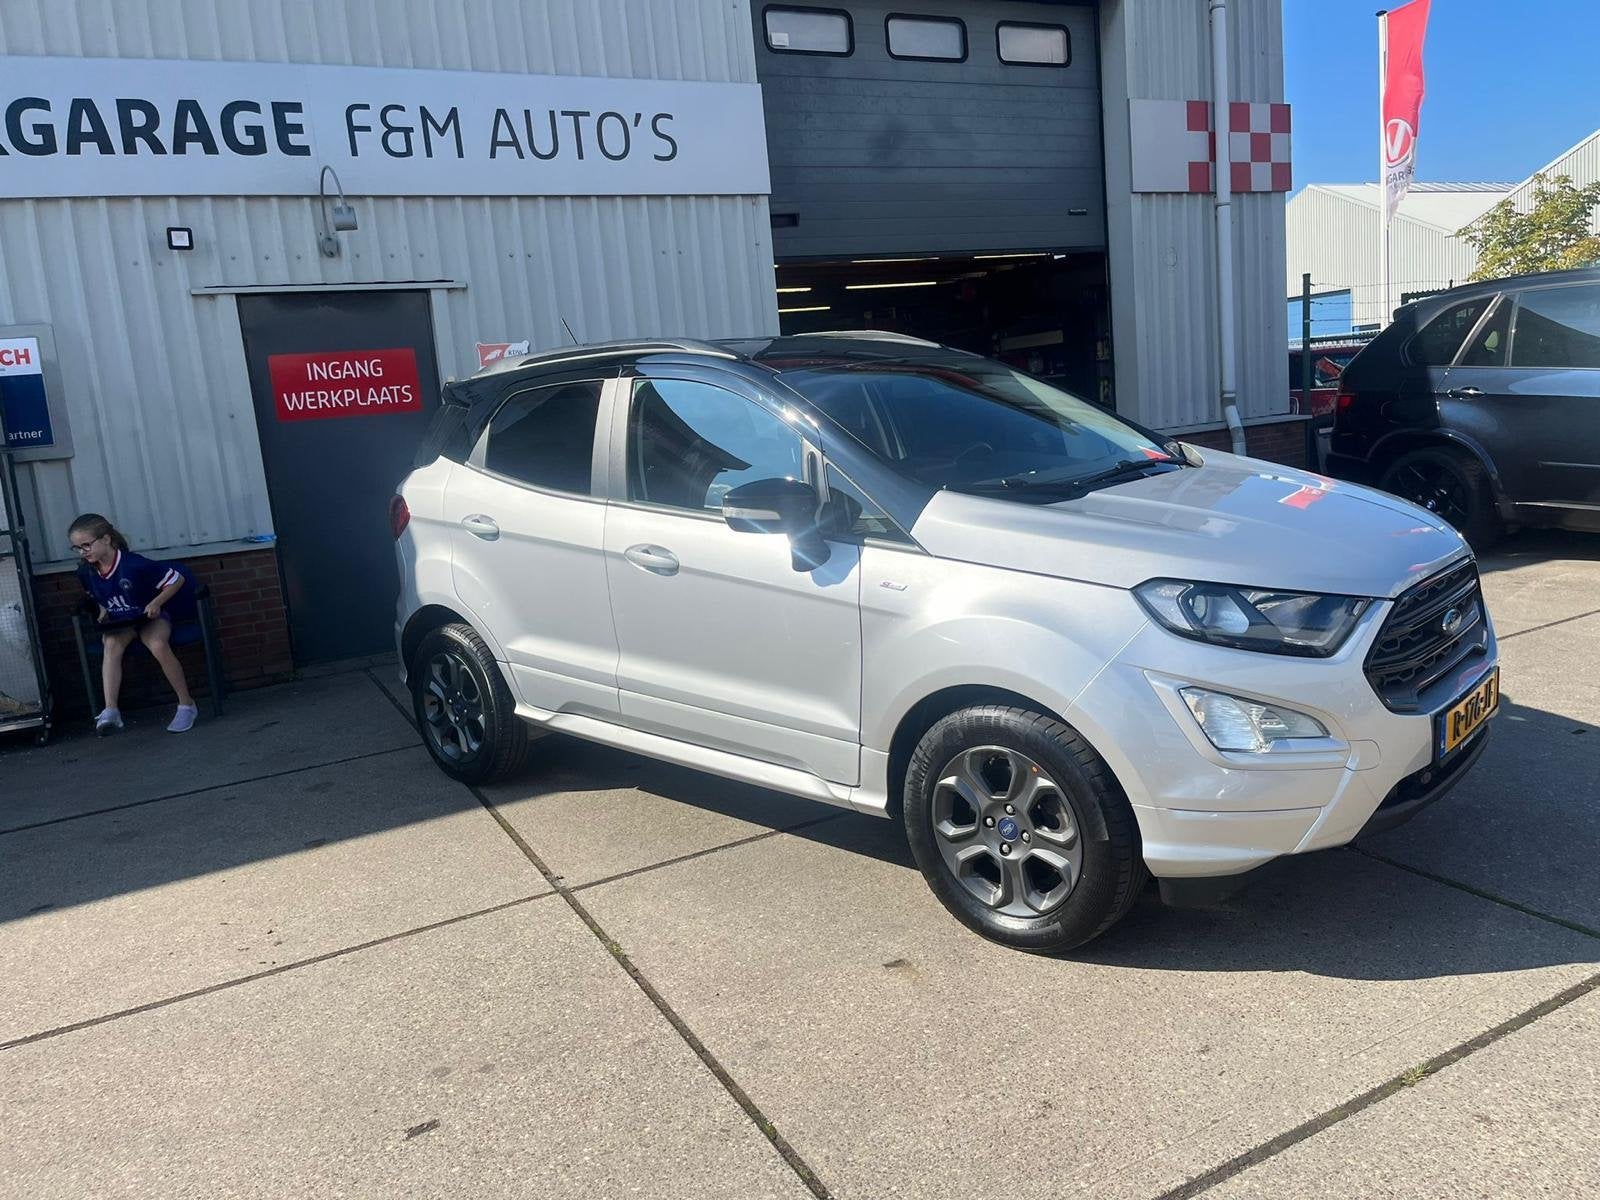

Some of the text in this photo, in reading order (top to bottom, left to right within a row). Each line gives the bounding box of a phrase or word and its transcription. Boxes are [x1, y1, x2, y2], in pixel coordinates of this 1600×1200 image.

[345, 103, 465, 159] F&M
[489, 108, 678, 162] AUTO'S
[306, 359, 383, 381] INGANG
[283, 385, 413, 411] WERKPLAATS
